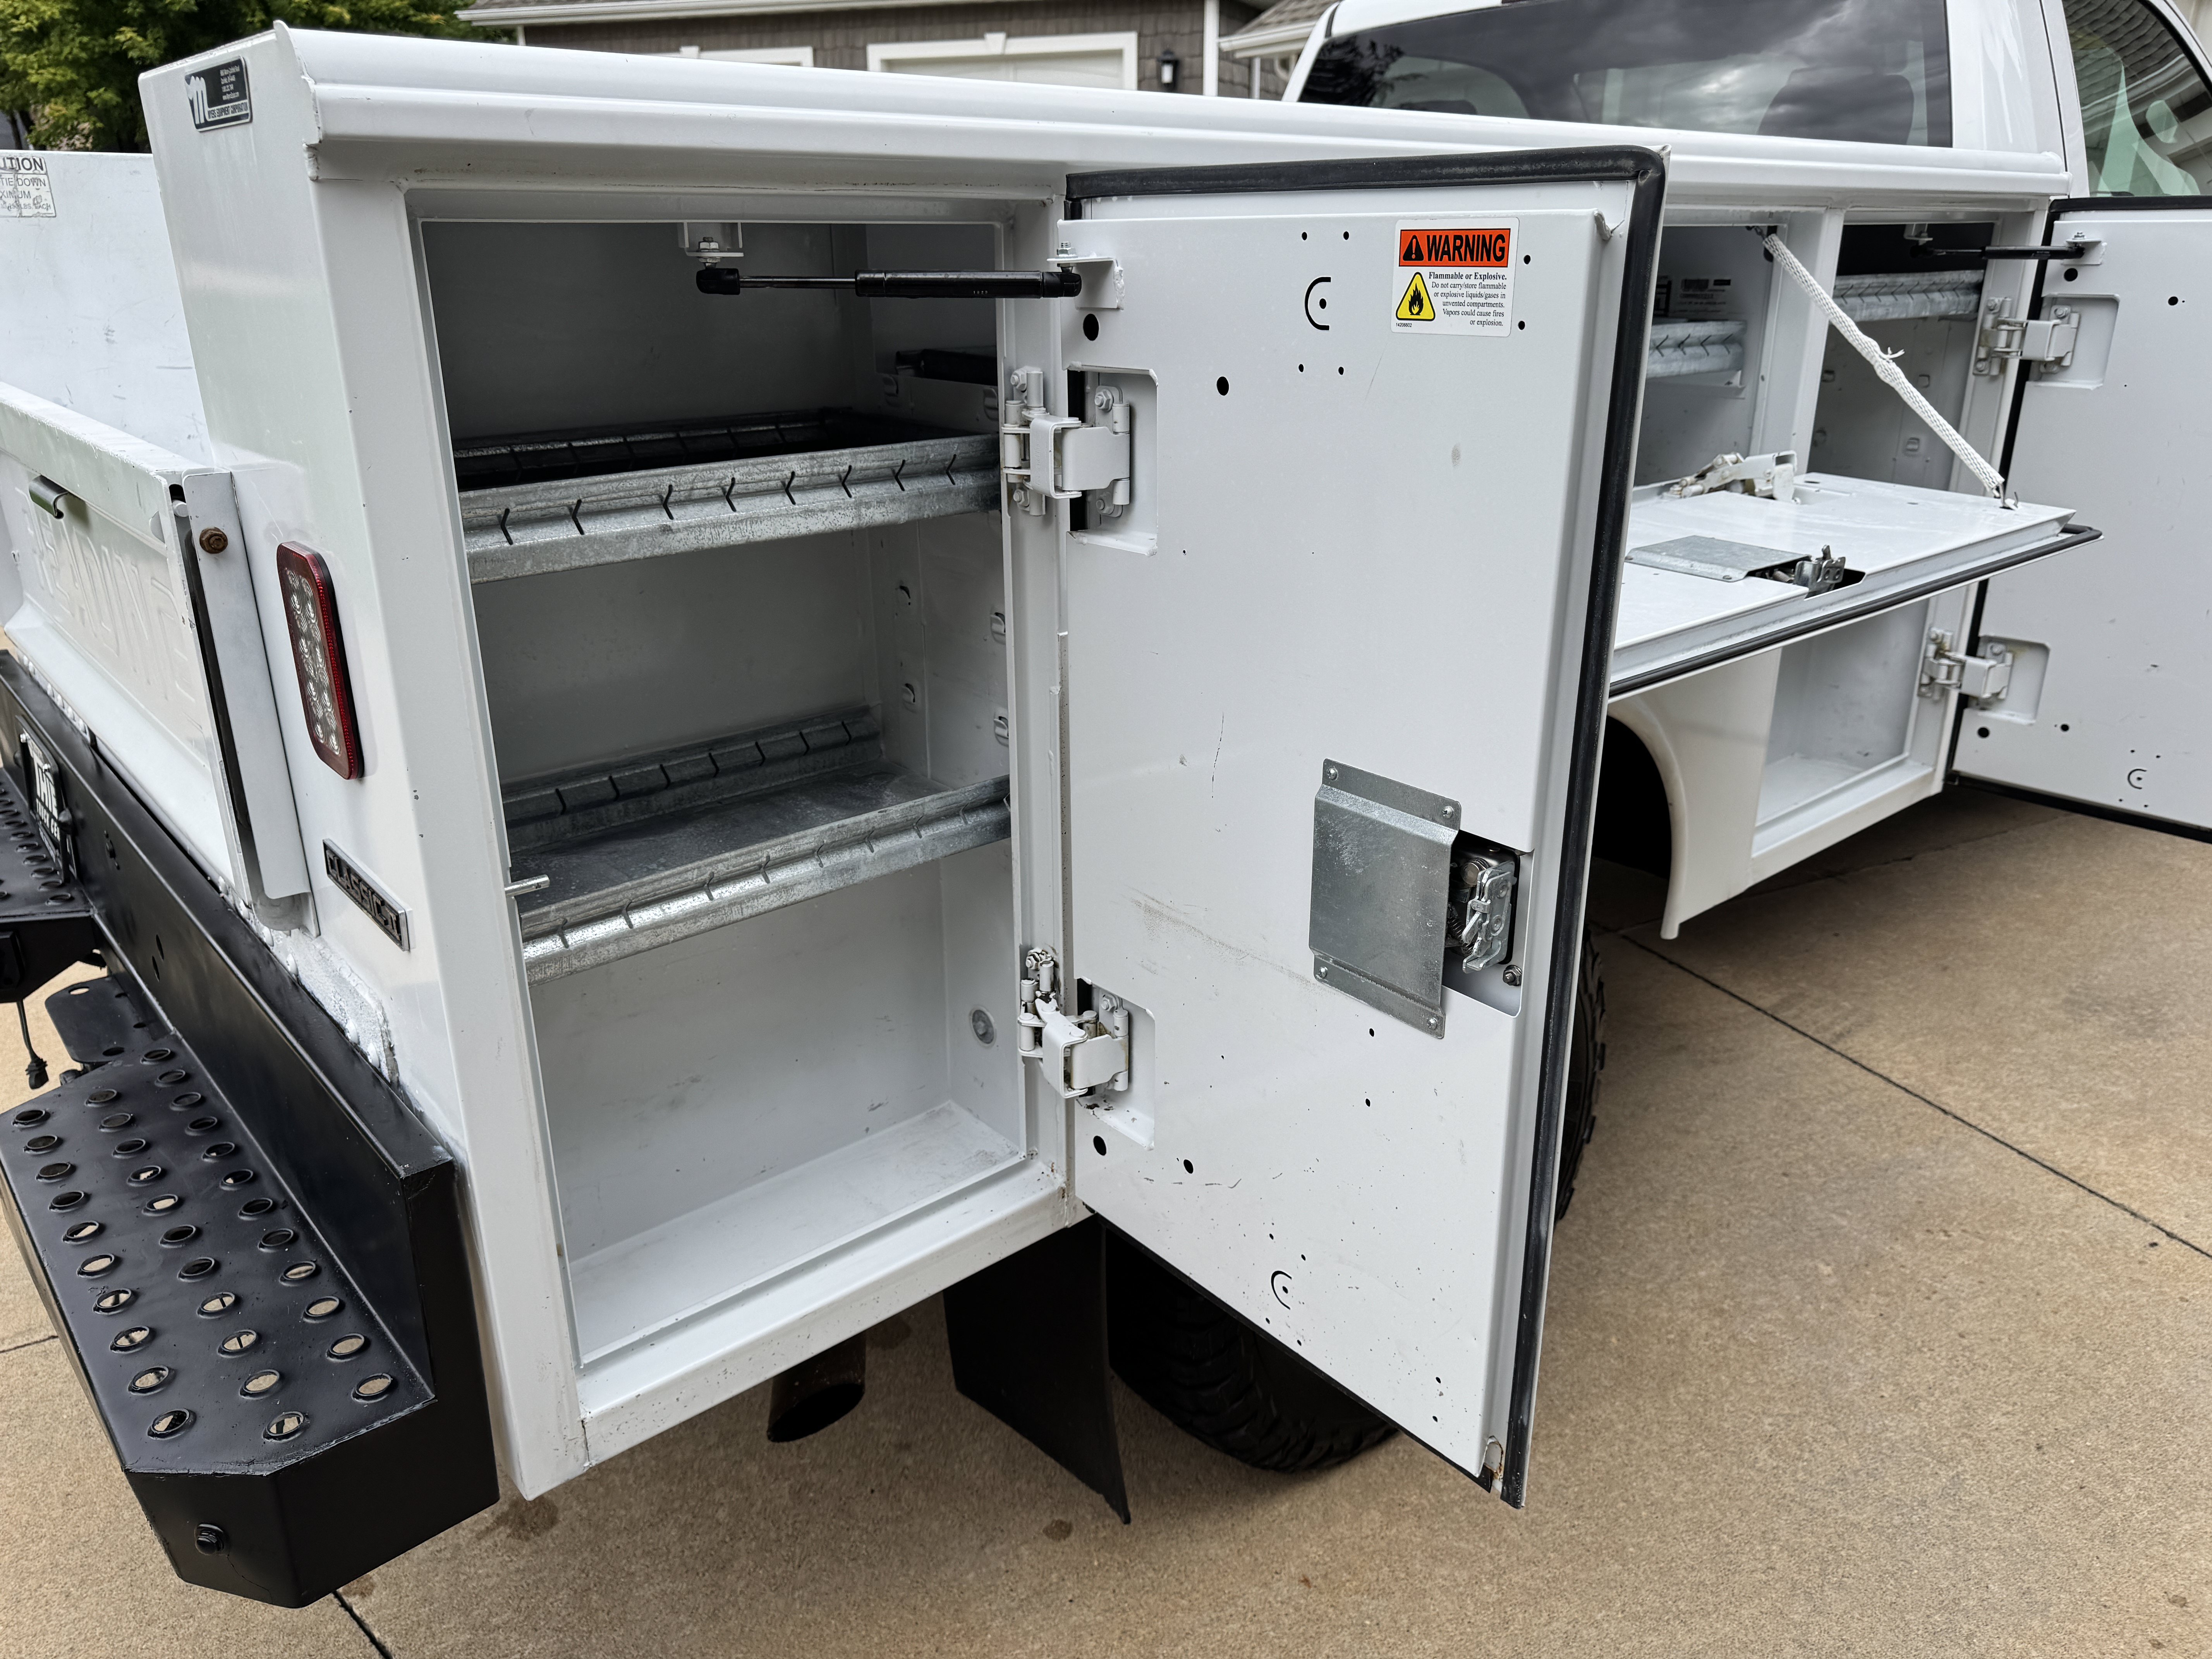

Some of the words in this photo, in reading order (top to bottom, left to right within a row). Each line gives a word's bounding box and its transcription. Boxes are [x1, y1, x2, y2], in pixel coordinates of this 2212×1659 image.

[17, 178, 46, 187] DOWN
[1426, 234, 1505, 262] WARNING
[1474, 272, 1507, 281] Explosive.
[1466, 291, 1499, 299] liquids/gases
[1443, 309, 1460, 317] Vapors
[326, 850, 388, 926] CLASSIC
